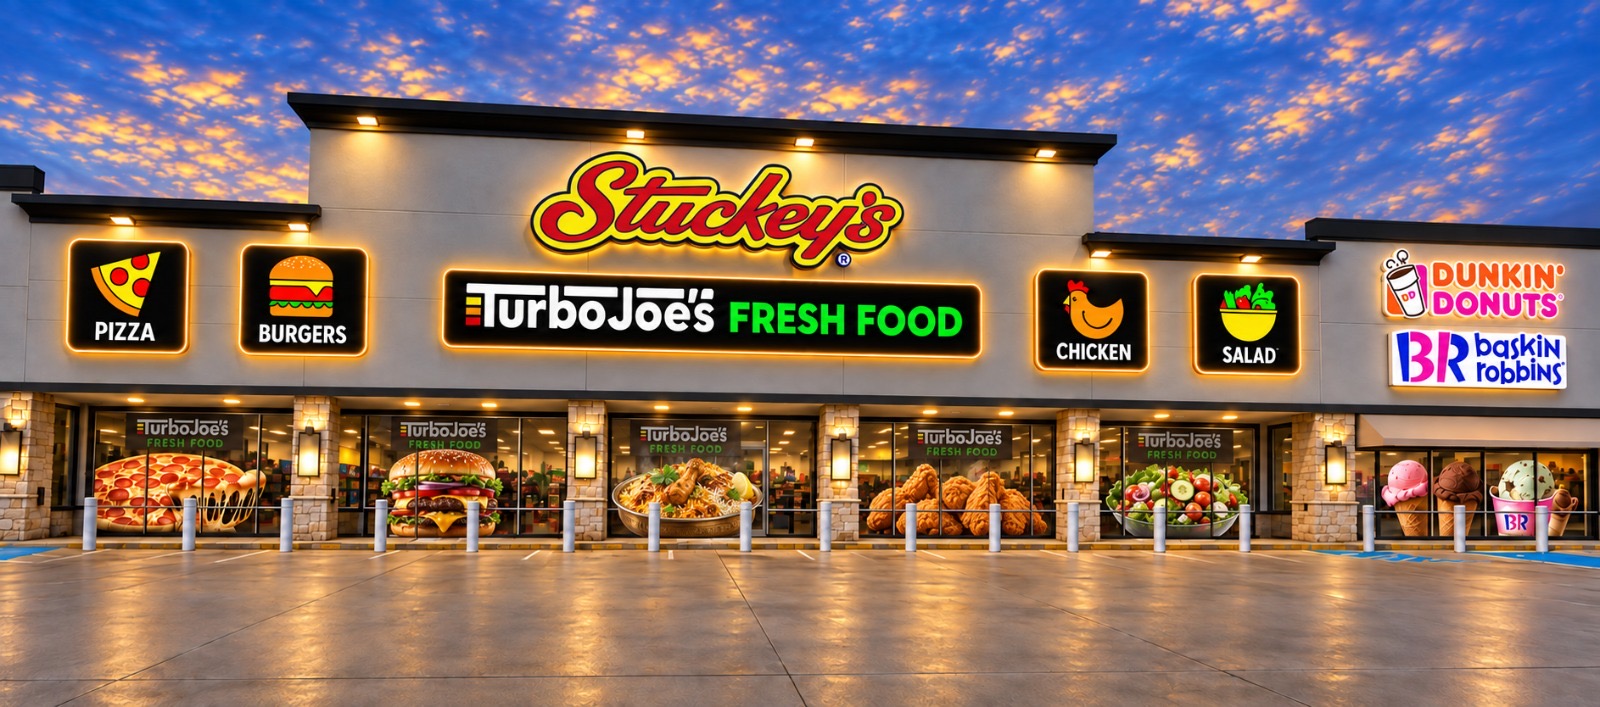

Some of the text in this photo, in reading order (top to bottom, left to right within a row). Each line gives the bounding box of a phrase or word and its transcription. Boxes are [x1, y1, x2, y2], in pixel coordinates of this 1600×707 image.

[538, 158, 896, 261] Stuckey's
[1432, 262, 1564, 290] DUNKIN'
[1401, 290, 1416, 302] DD
[1432, 291, 1558, 318] DONUTS
[466, 282, 963, 338] TurboJoe's FRESH FOOD
[94, 321, 156, 342] PIZZA
[258, 323, 347, 345] BURGERS
[1056, 342, 1132, 361] CHICKEN
[1222, 345, 1277, 364] SALAD
[1396, 331, 1469, 383] BR
[146, 438, 224, 448] FRESH FOOD
[408, 440, 481, 450] FRESH FOOD
[649, 444, 722, 454] FRESH FOOD
[926, 447, 998, 456] FRESH FOOD
[1147, 450, 1217, 460] FRESH FOOD
[1504, 514, 1529, 531] BR
